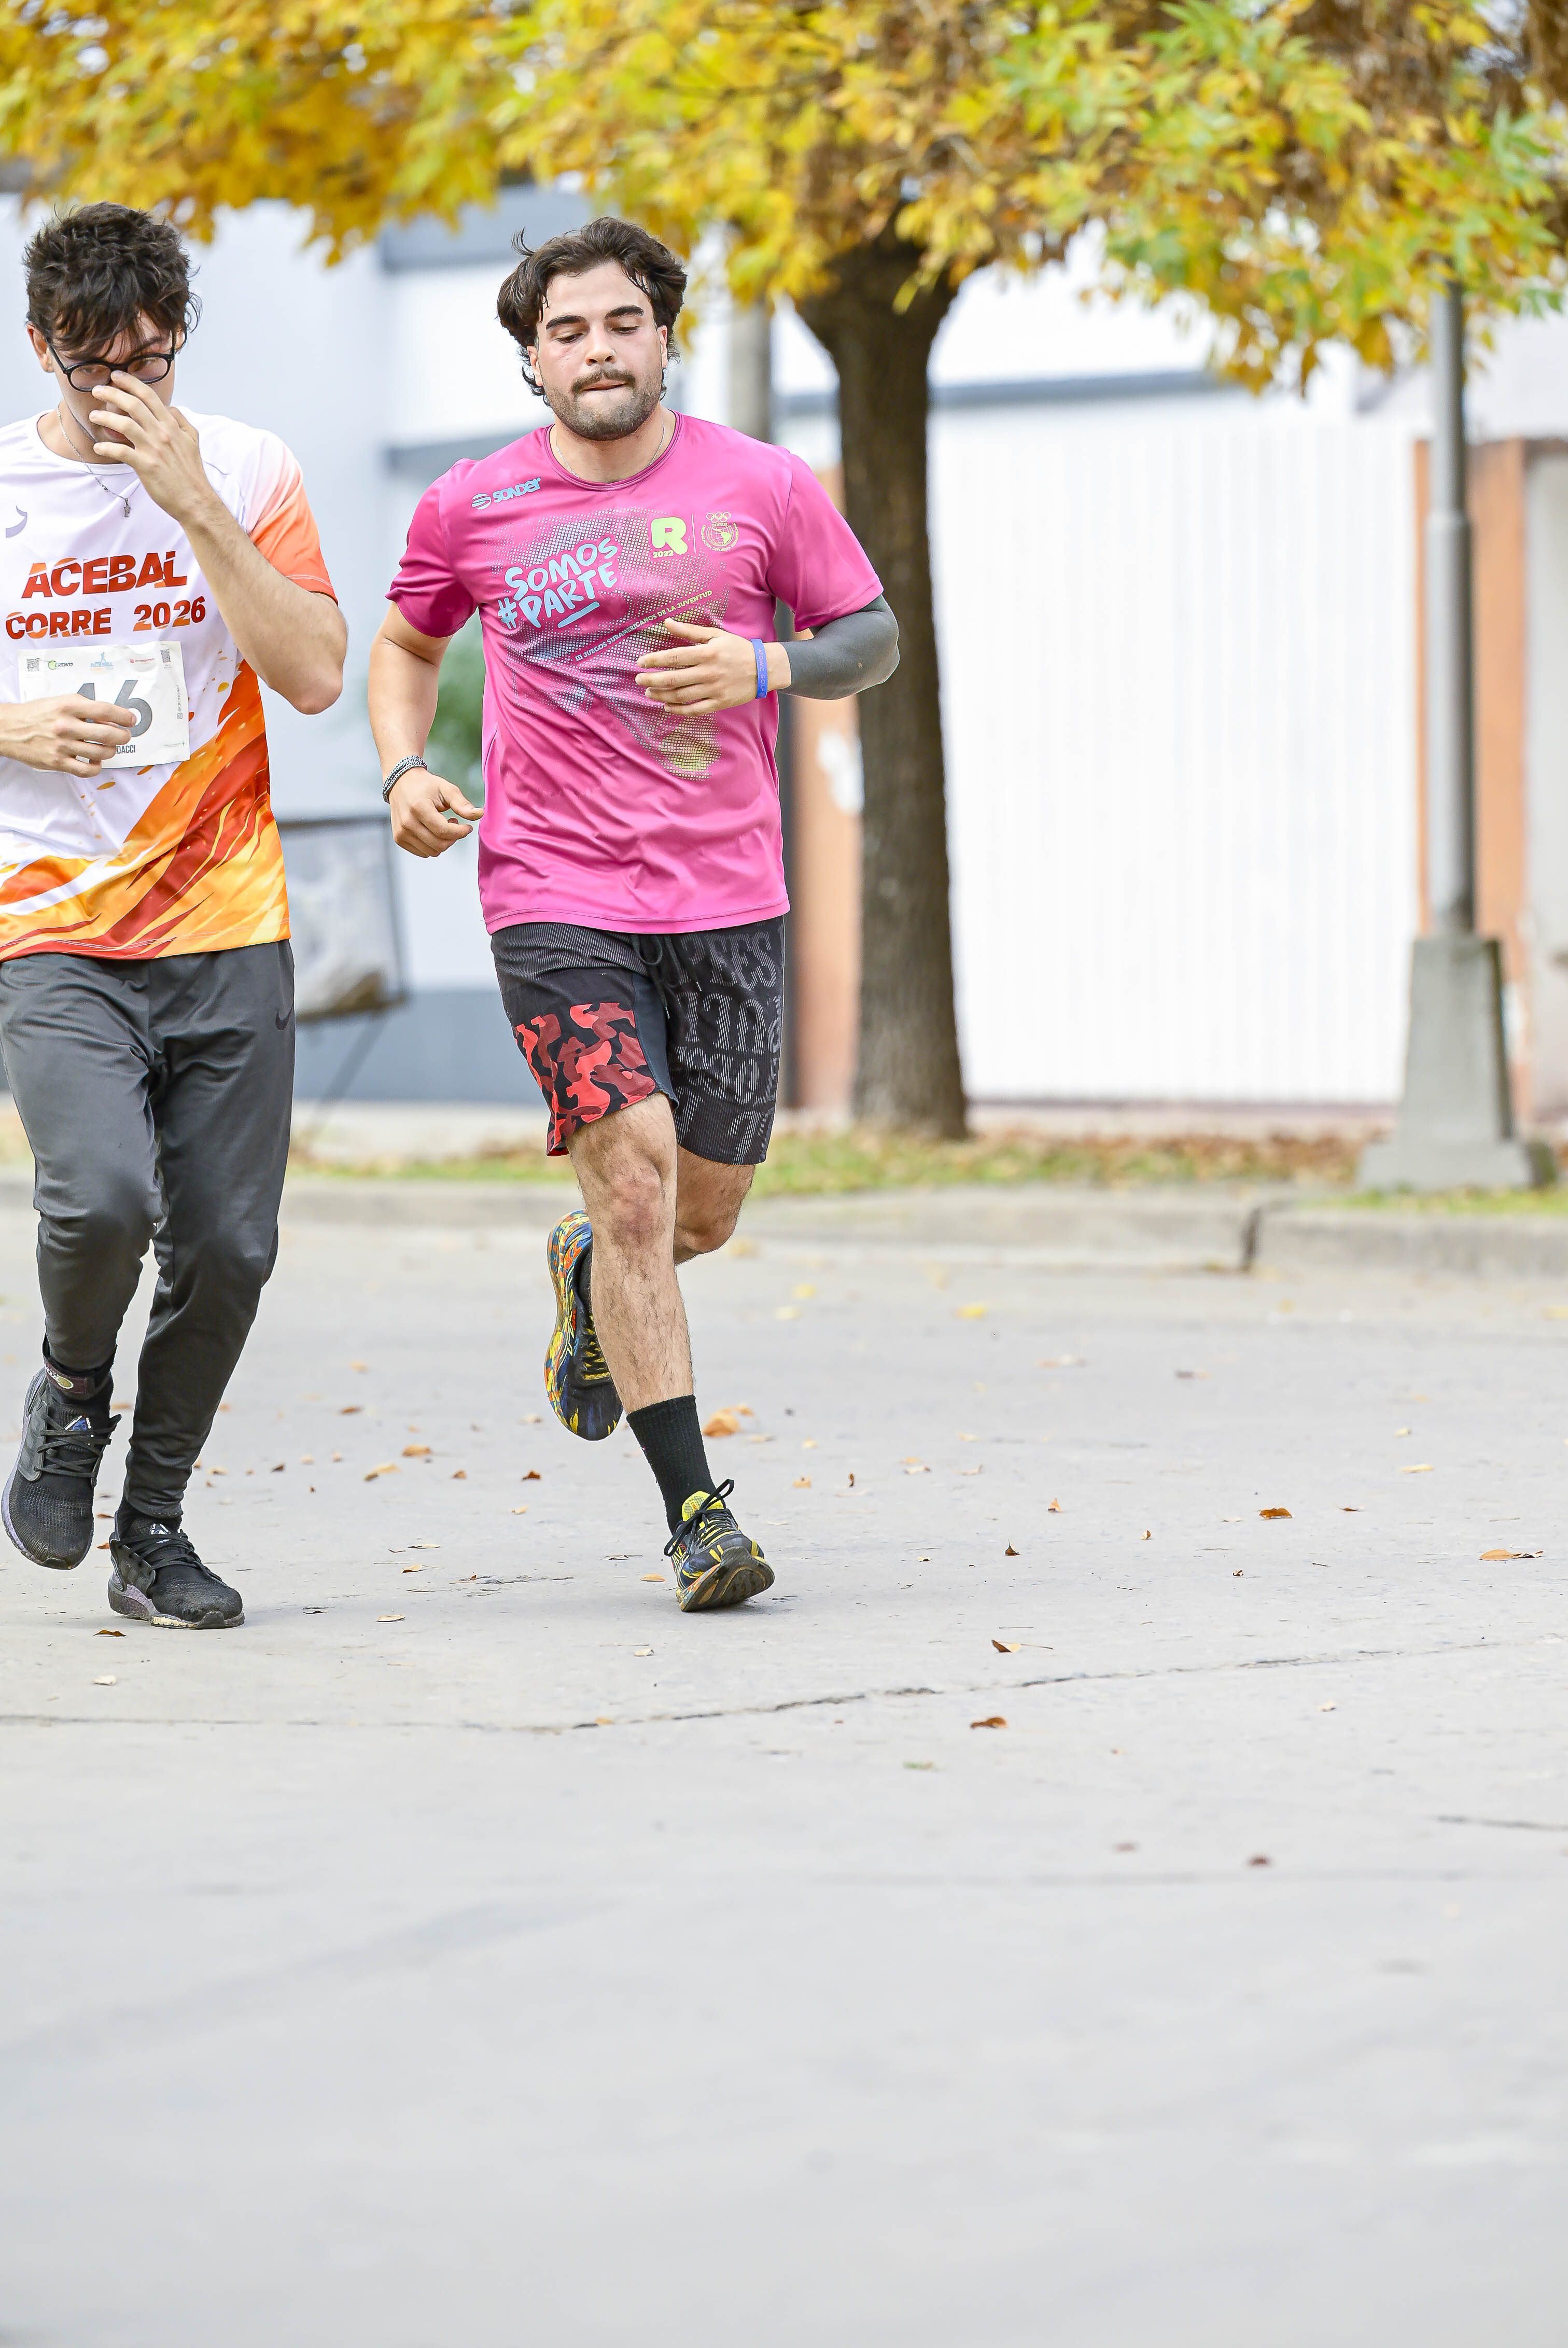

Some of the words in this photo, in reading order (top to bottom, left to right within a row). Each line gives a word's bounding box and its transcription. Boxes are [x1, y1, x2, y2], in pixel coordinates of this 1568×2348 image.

[651, 516, 688, 555] R
[652, 549, 674, 558] 2022
[21, 551, 187, 598] ACEBAL
[505, 537, 618, 601] SOMOS
[6, 608, 111, 639] CORRE
[133, 596, 206, 632] 2026
[498, 562, 617, 630] #PARTE
[583, 641, 607, 658] JUEGOS
[607, 614, 657, 645] SURAMERICANOS
[677, 590, 712, 608] JUVENTUD
